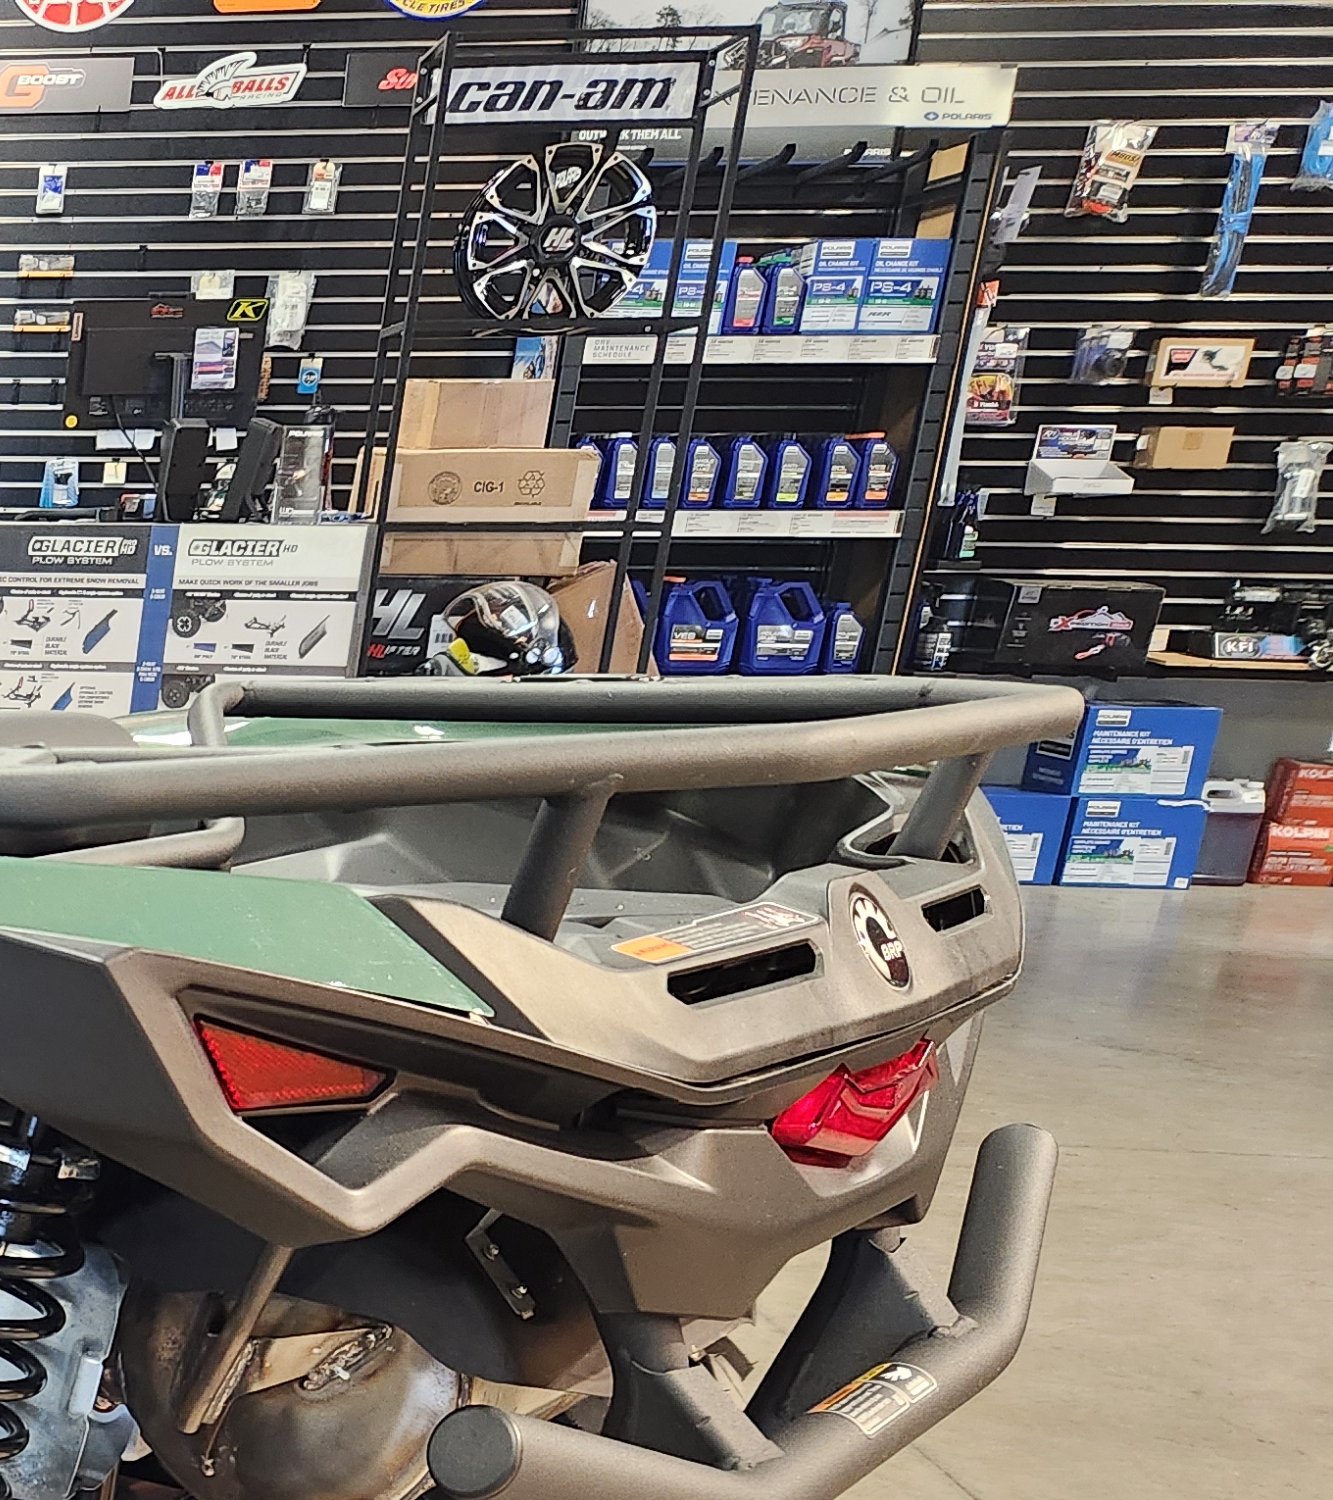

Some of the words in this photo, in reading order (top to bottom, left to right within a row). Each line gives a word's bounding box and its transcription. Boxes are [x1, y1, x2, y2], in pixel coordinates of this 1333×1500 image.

[429, 0, 465, 14] TIRES
[18, 73, 83, 87] BOOST
[161, 85, 194, 101] ALL
[232, 77, 290, 95] BALLS
[239, 91, 283, 100] RACING
[446, 78, 677, 113] can-am
[888, 87, 909, 102] &
[921, 87, 965, 104] OIL
[942, 113, 992, 121] POLARIS
[631, 129, 661, 140] THEM
[661, 129, 682, 140] ALL
[870, 282, 912, 293] PS-4
[41, 538, 117, 554] GLACIER
[154, 545, 173, 556] VS.
[200, 540, 279, 556] GLACIER
[284, 544, 298, 553] HD
[32, 556, 65, 565] PLOW
[67, 556, 113, 565] SYSTEM
[227, 559, 273, 567] SYSTEM
[1226, 641, 1253, 653] KFI
[1093, 730, 1139, 738] MAINTENANCE
[1271, 826, 1330, 839] KOLPIN
[881, 941, 903, 961] BRP
